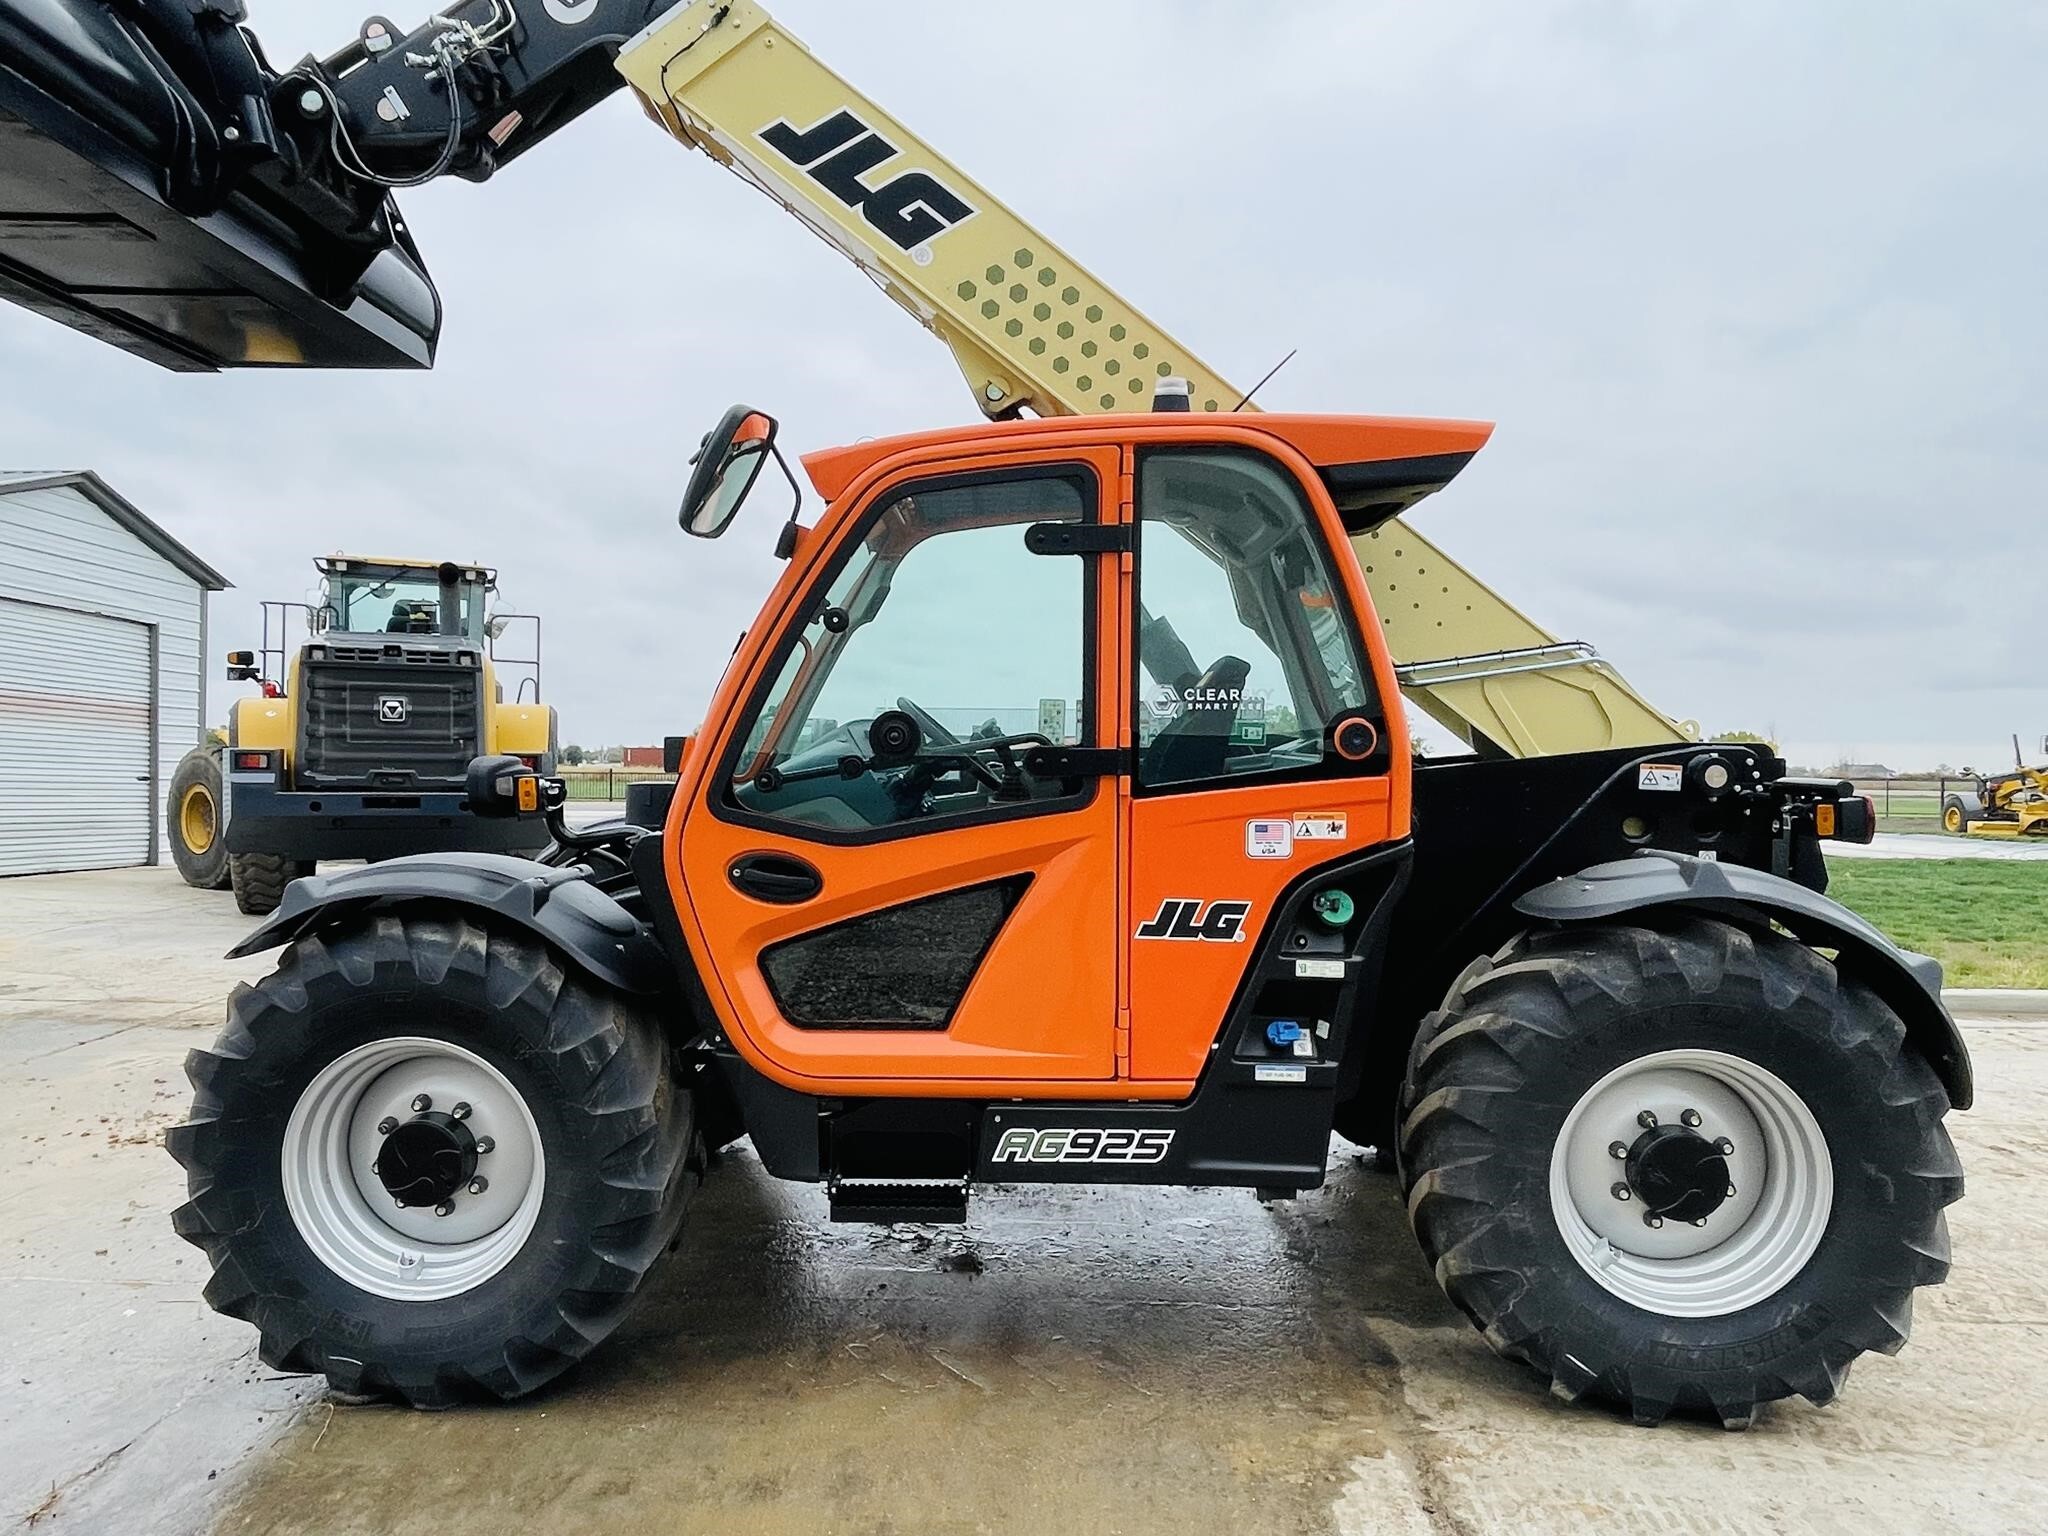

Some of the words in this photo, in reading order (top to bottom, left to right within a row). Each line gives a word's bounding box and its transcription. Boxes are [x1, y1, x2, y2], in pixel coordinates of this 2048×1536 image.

[754, 107, 979, 253] JLG
[1187, 702, 1228, 711] SMART
[1135, 899, 1251, 941] JLG
[992, 1128, 1176, 1163] AG925
